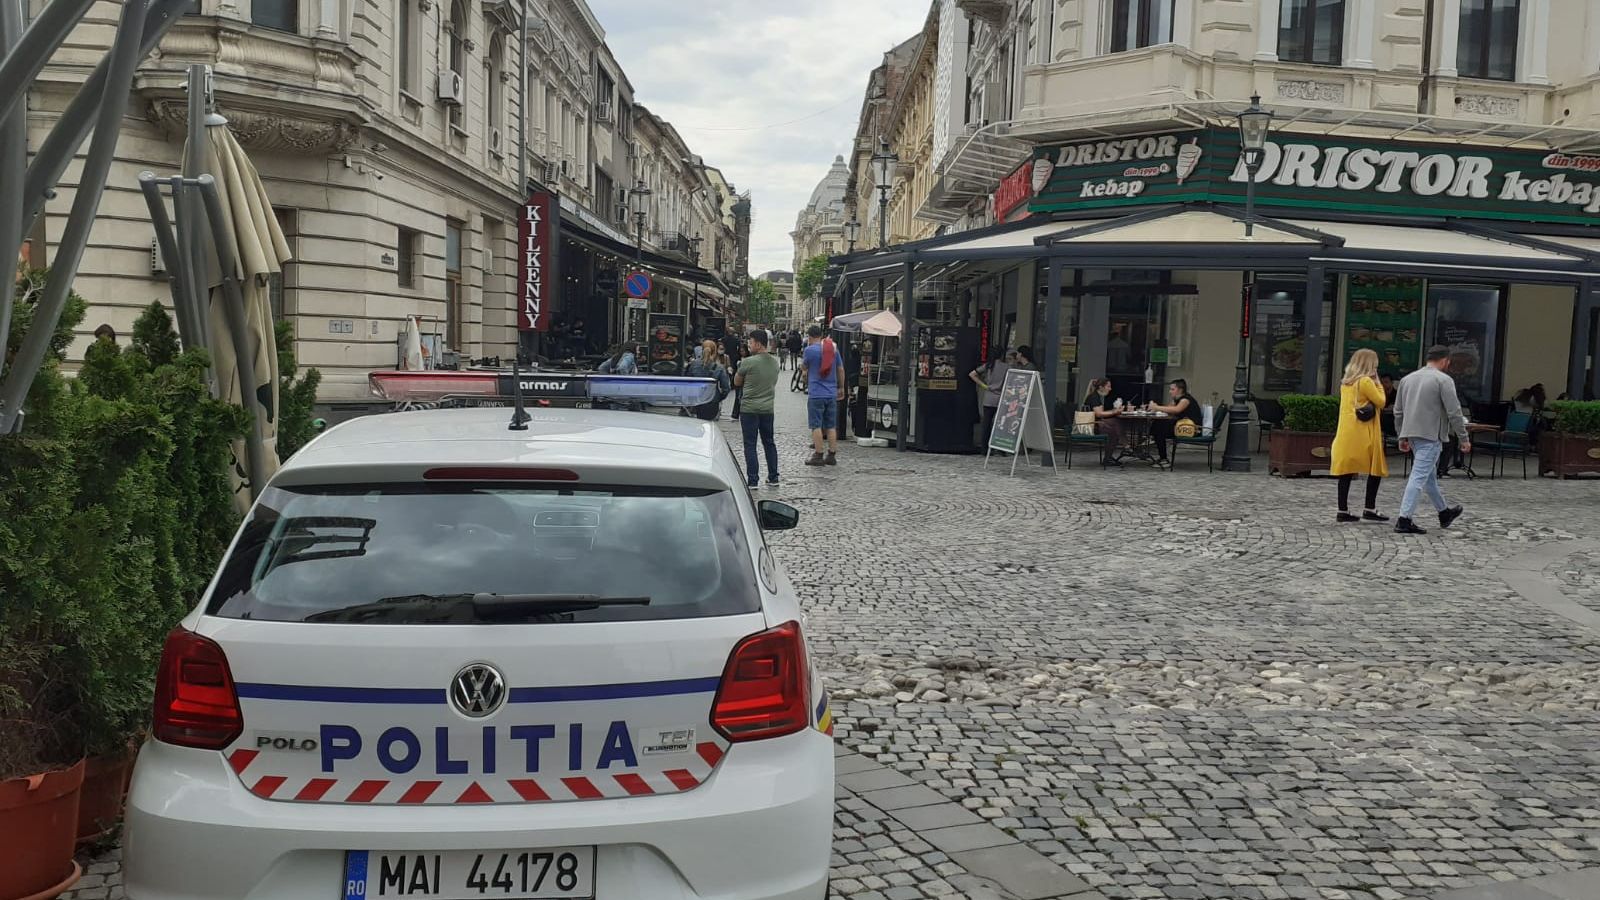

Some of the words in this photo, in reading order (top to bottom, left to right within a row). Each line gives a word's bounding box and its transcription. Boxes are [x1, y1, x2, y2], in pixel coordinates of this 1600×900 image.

[1055, 135, 1178, 167] DRISTOR
[1547, 154, 1569, 167] din
[1229, 142, 1493, 199] DRISTOR
[1079, 178, 1145, 198] kebap
[525, 205, 542, 329] KILKENNY
[519, 381, 568, 390] armas
[257, 735, 318, 752] POLO
[320, 720, 638, 774] POLITIA
[379, 855, 441, 895] MAI
[466, 853, 578, 893] 44178
[346, 880, 366, 896] RO
